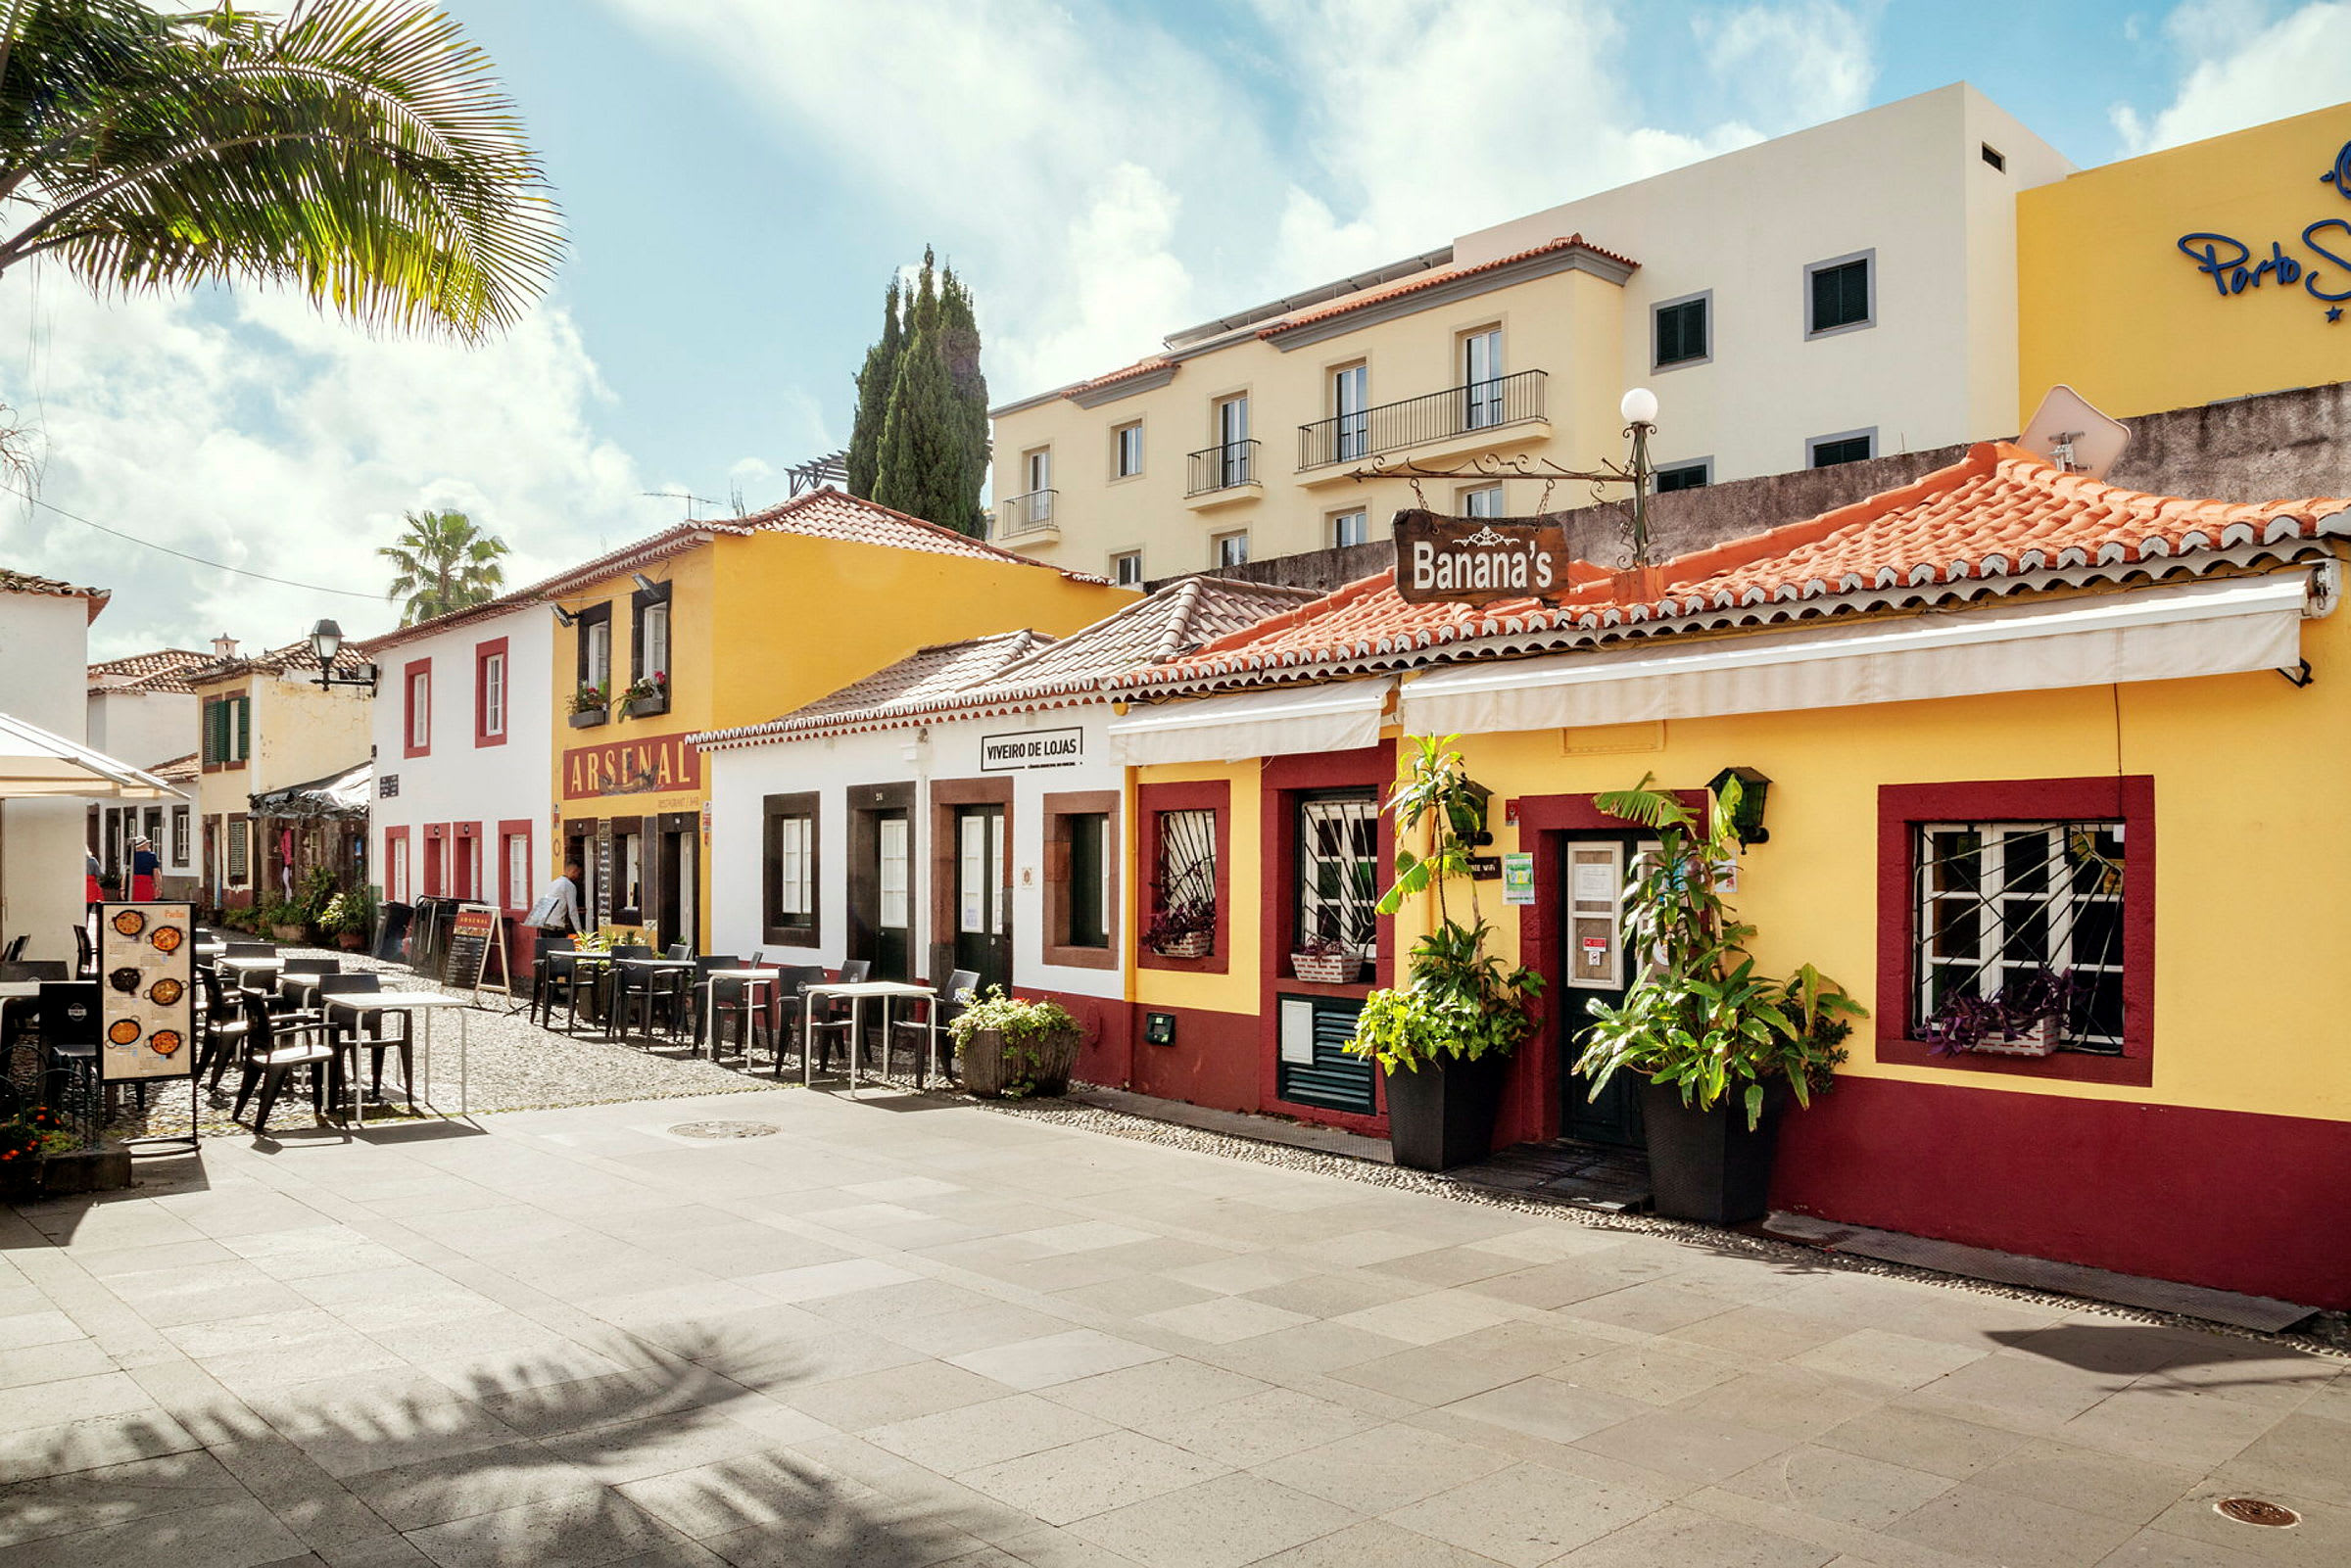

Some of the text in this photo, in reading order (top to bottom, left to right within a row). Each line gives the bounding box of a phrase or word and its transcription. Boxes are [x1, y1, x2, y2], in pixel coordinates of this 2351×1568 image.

[2178, 232, 2301, 296] Porto
[1414, 541, 1553, 590] Banana's
[571, 740, 691, 793] ARSENAL
[986, 738, 1077, 760] VIVEIRO DE LOJAS
